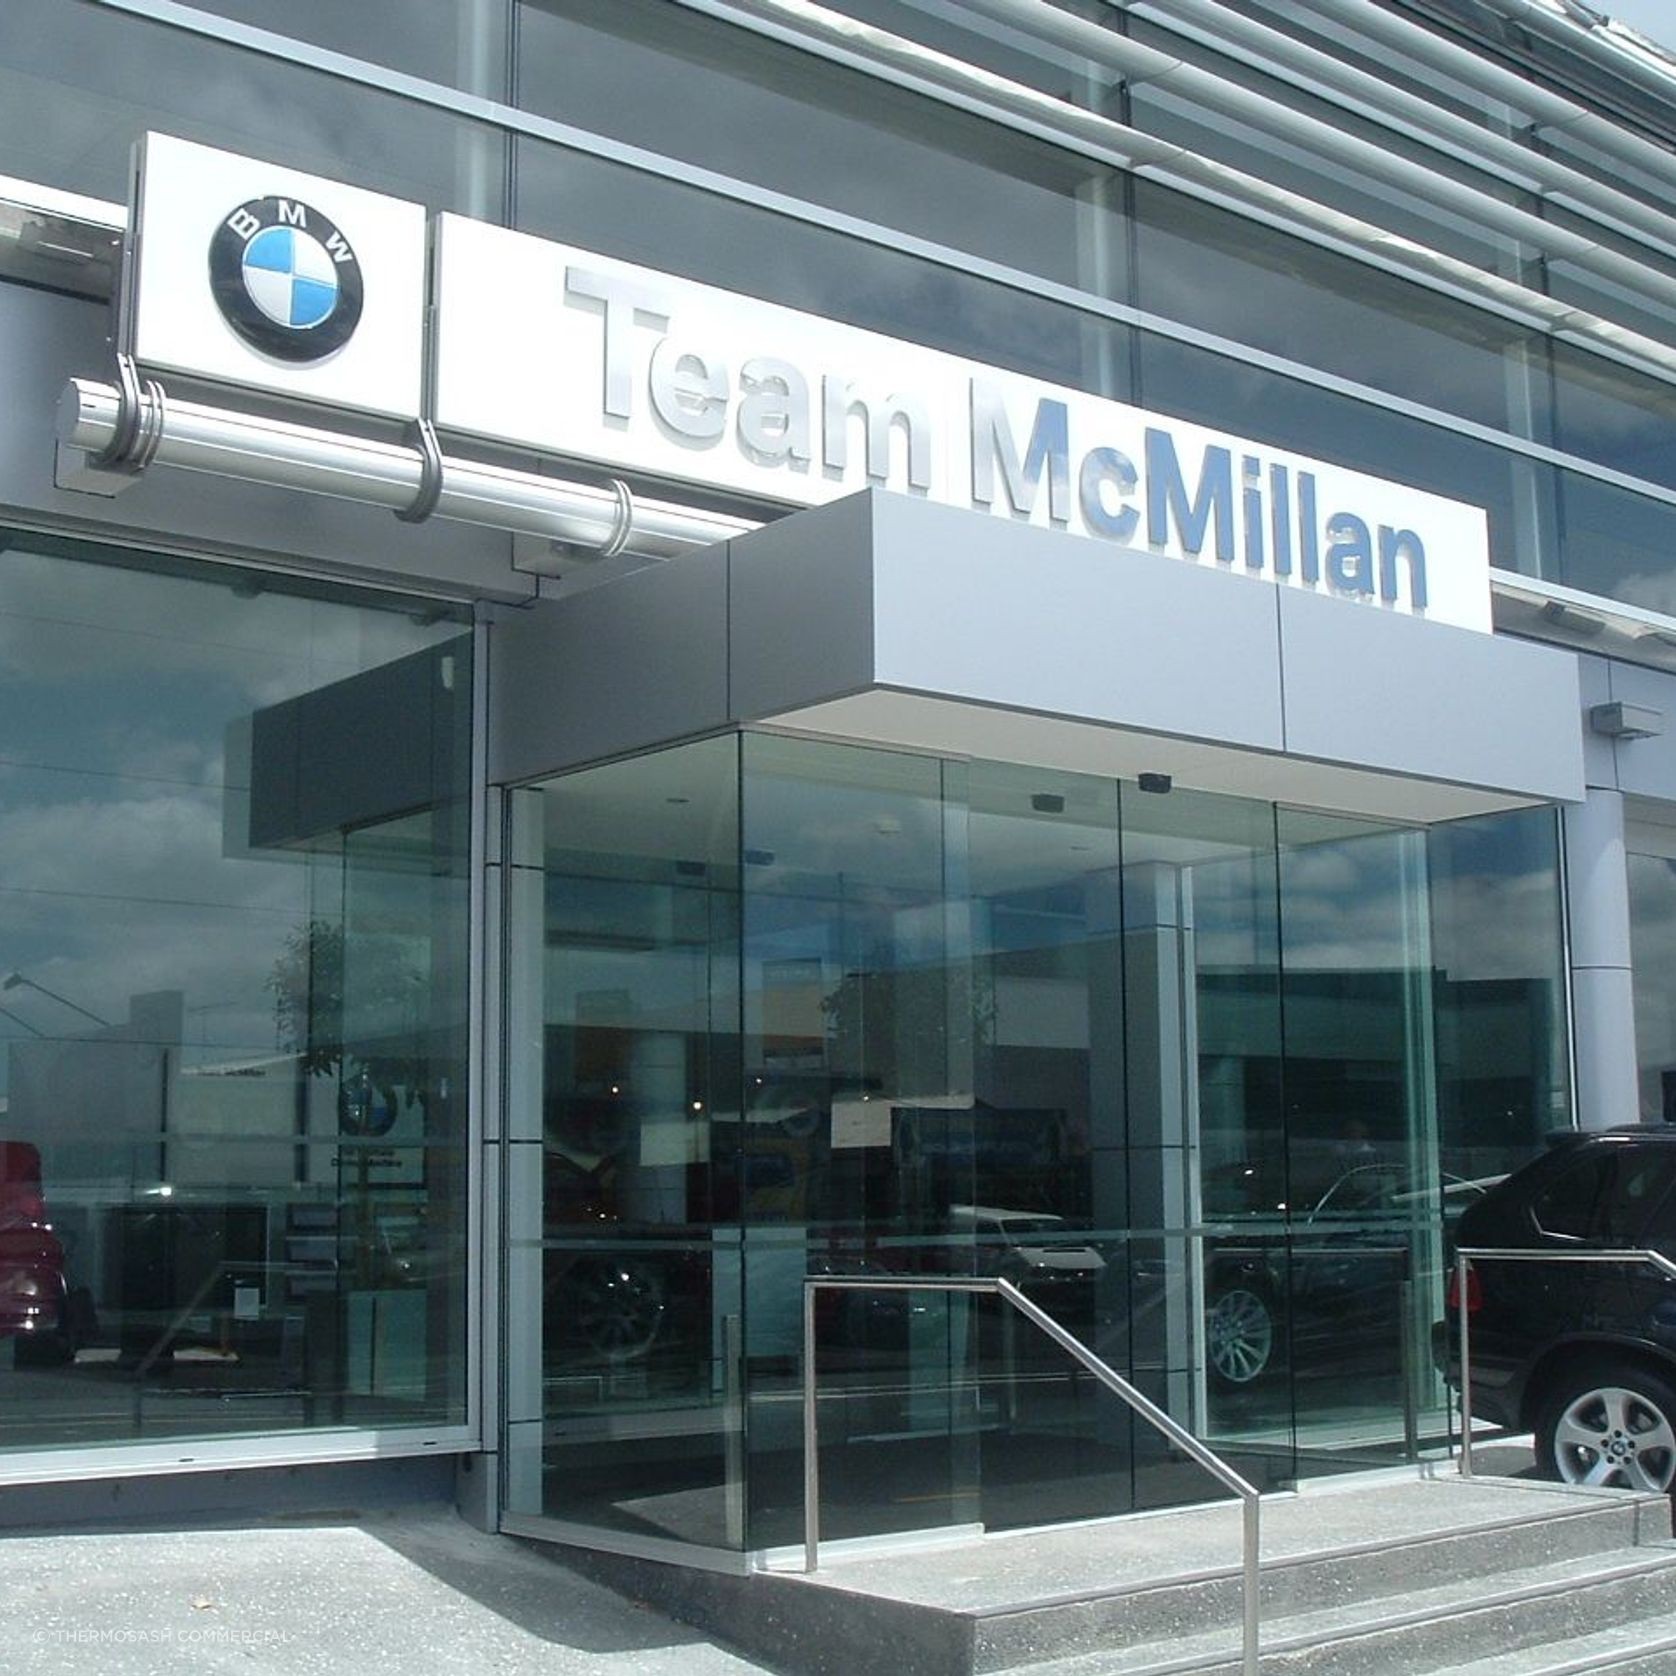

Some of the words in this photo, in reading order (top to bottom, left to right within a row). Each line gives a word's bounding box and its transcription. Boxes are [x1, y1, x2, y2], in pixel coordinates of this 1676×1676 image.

[227, 200, 353, 263] BMW
[565, 266, 931, 489] Team
[969, 378, 1428, 609] McMillan
